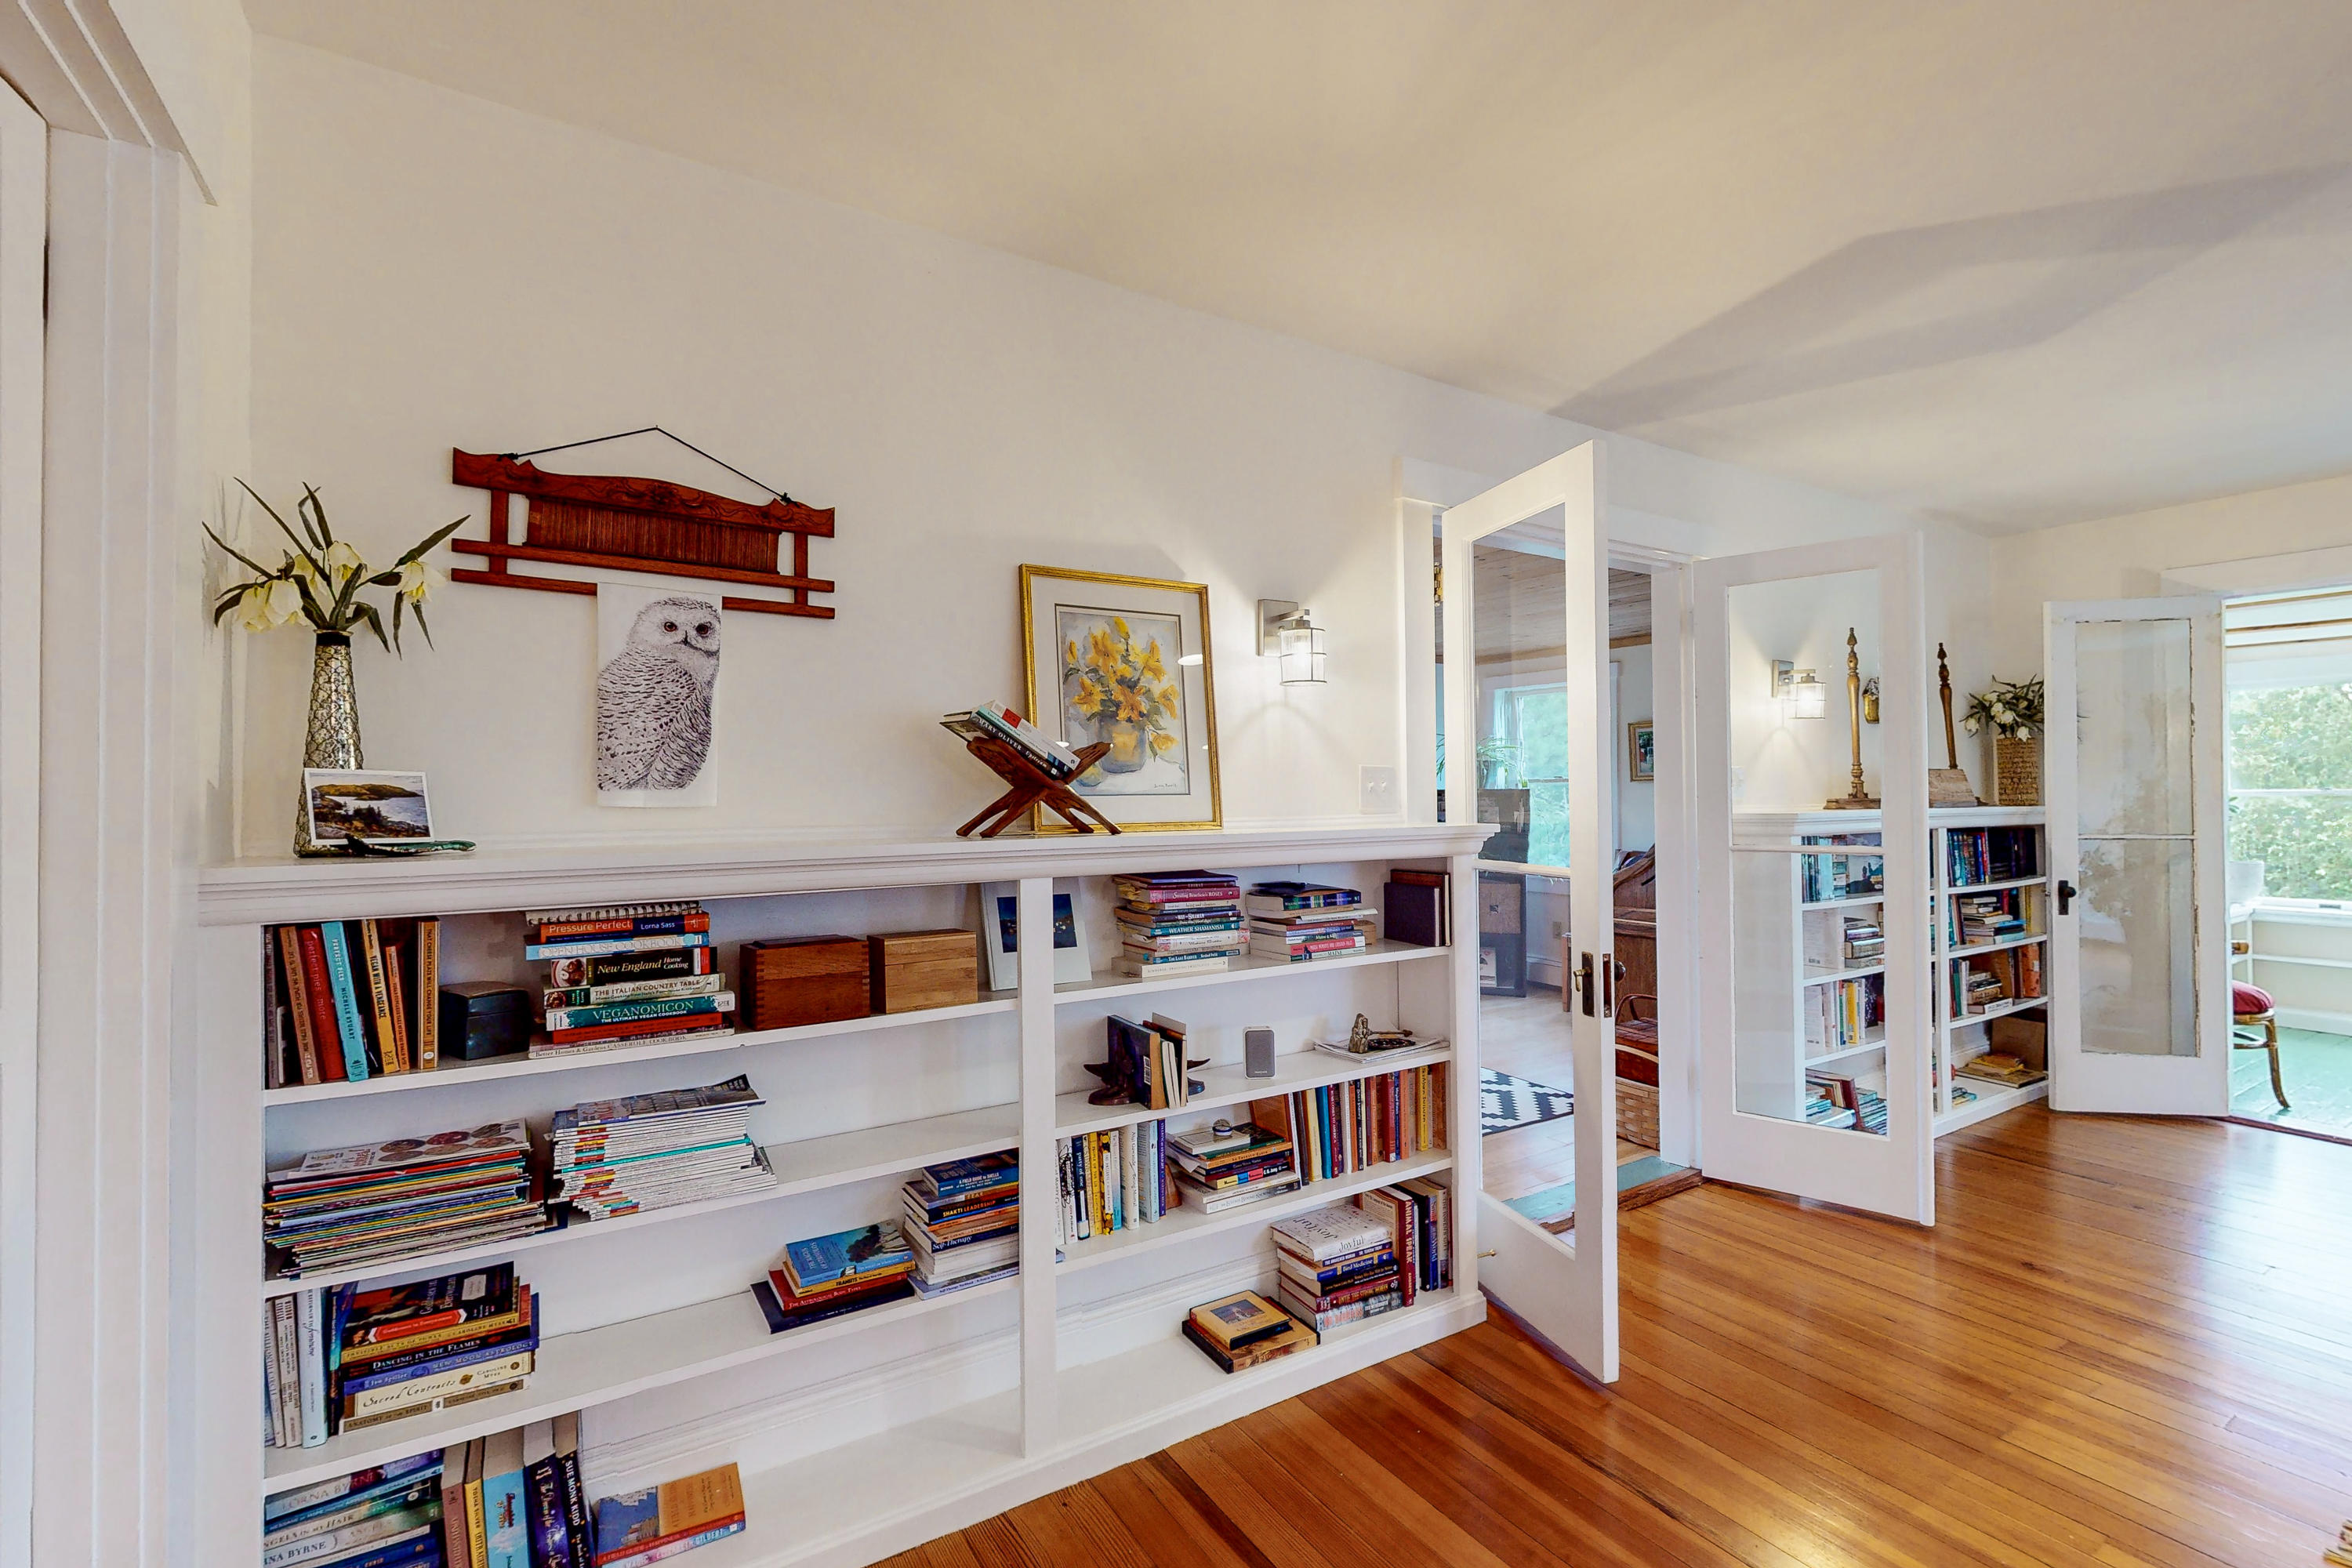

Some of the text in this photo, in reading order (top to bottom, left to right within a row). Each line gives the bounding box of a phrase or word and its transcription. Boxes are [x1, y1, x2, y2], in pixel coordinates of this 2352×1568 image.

[979, 718, 996, 733] MARY
[998, 732, 1022, 751] OLIVER
[1025, 751, 1047, 768] Upstream
[550, 923, 593, 934] Pressure
[595, 920, 630, 930] Perfect
[543, 938, 681, 956] OPEN HOUSE COOKBOOK
[369, 956, 379, 973] VEGAN
[597, 964, 620, 974] New
[621, 960, 662, 972] England
[307, 941, 326, 1020] perfect pies more
[372, 972, 382, 985] WITH
[332, 938, 355, 1040] PERFECT PIES MICHELE STUART
[612, 985, 641, 995] ITALIAN
[643, 982, 678, 991] COUNTRY
[376, 990, 387, 1019] VENGEANCE
[593, 1000, 695, 1019] VEGANOMICON
[942, 1200, 996, 1218] SHAKTI LEADERSHIP
[1404, 1201, 1413, 1235] ANIMAL
[1292, 1219, 1338, 1240] Joyful
[932, 1236, 972, 1250] Self-Therapy
[1338, 1236, 1364, 1253] Joyful
[1353, 1258, 1374, 1269] Medicine
[1351, 1291, 1359, 1301] THE
[1359, 1287, 1374, 1298] STRONG
[1374, 1283, 1388, 1293] WOMAN
[372, 1355, 412, 1370] DANCING
[428, 1347, 445, 1356] THE
[447, 1339, 481, 1352] FLAMES
[432, 1340, 534, 1369] NEW MOON ASTROLOGY
[384, 1374, 408, 1383] Spiller
[363, 1379, 456, 1407] Sacred Contracts
[347, 1405, 428, 1428] ANATOMY SPIRIT
[281, 1469, 375, 1511] LORNA BYRNE
[568, 1478, 578, 1504] MONK
[571, 1504, 580, 1526] KIDD
[695, 1529, 724, 1546] GILBERT
[288, 1541, 326, 1559] BYRNE
